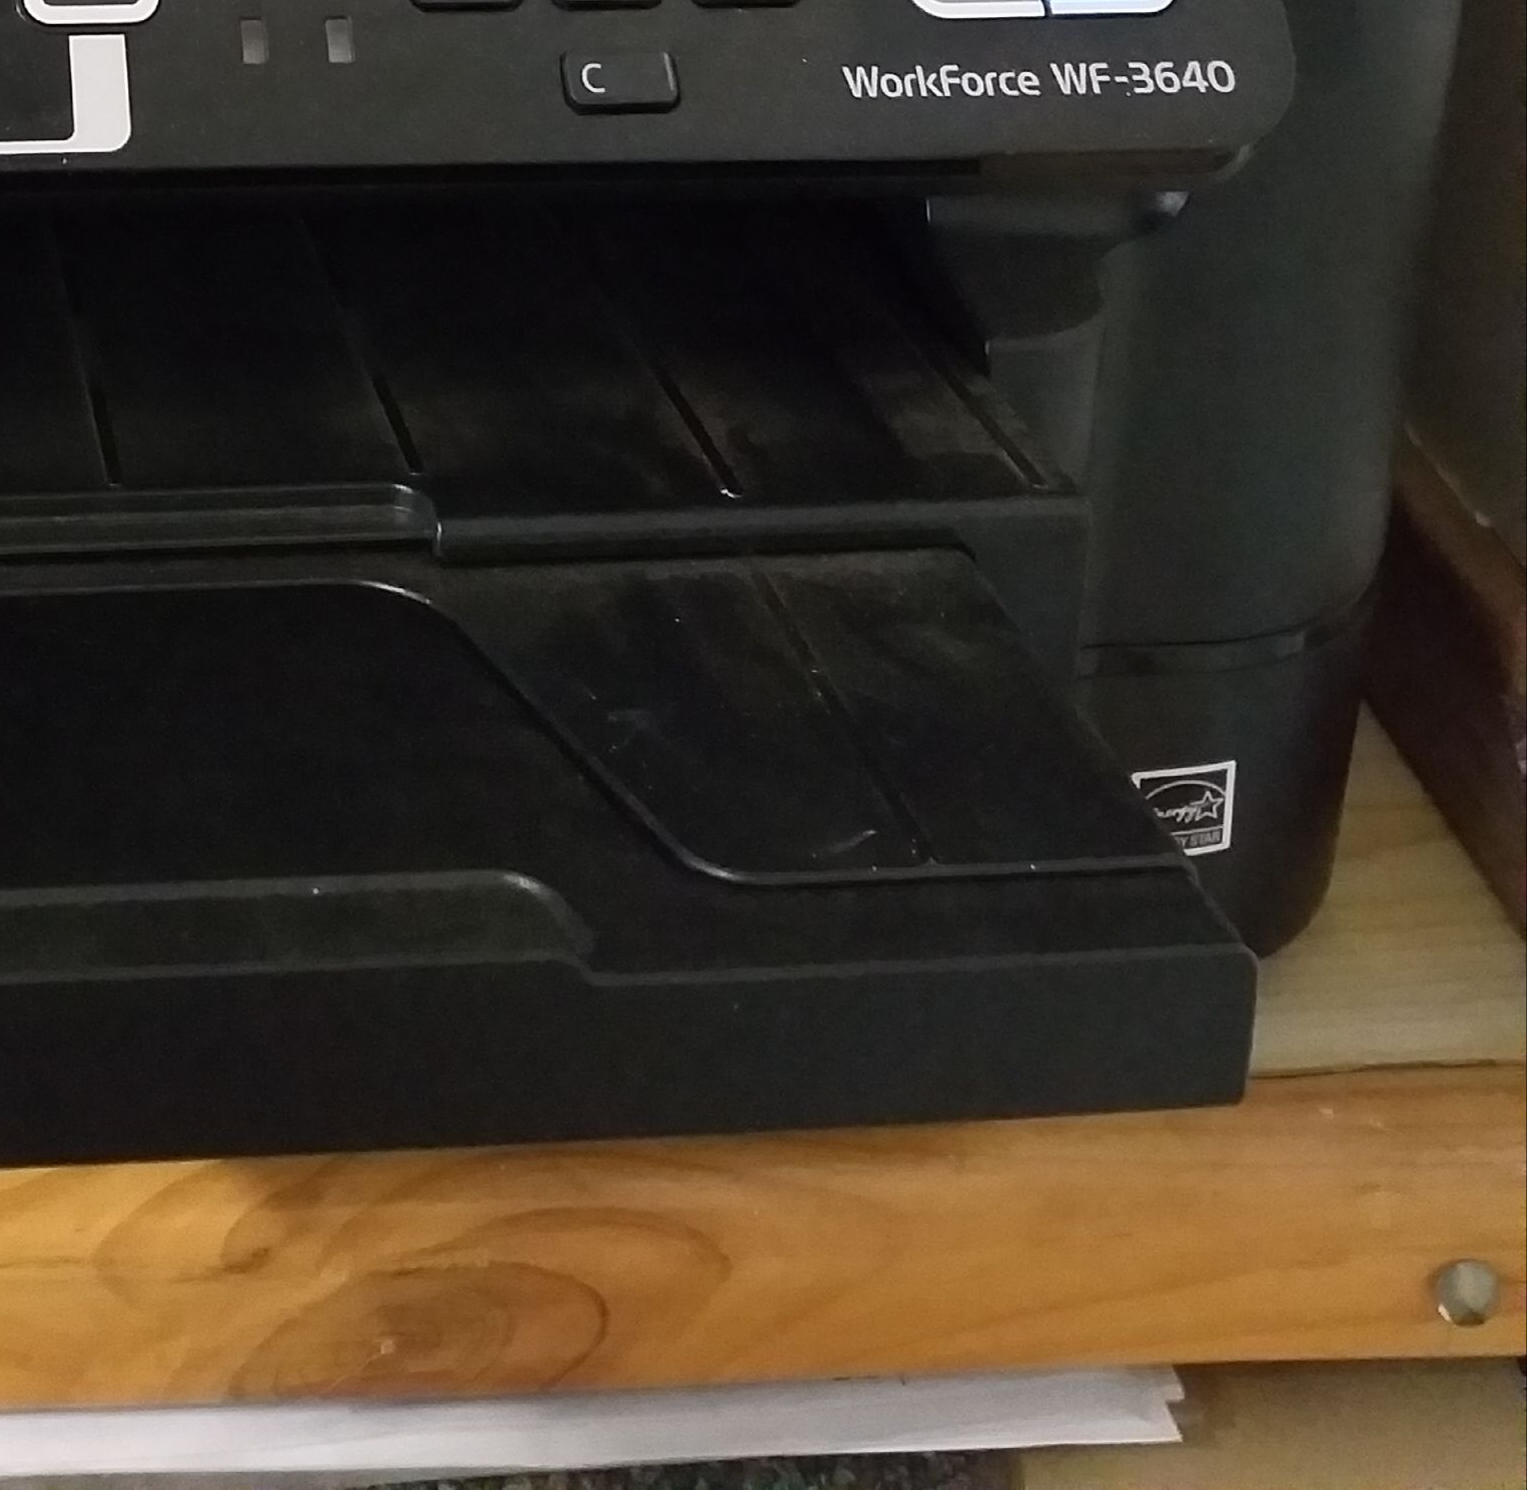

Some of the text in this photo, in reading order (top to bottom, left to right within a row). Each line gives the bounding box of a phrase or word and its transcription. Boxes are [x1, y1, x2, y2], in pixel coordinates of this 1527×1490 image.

[581, 63, 606, 93] C
[842, 60, 1236, 98] WorkForce WF-3640
